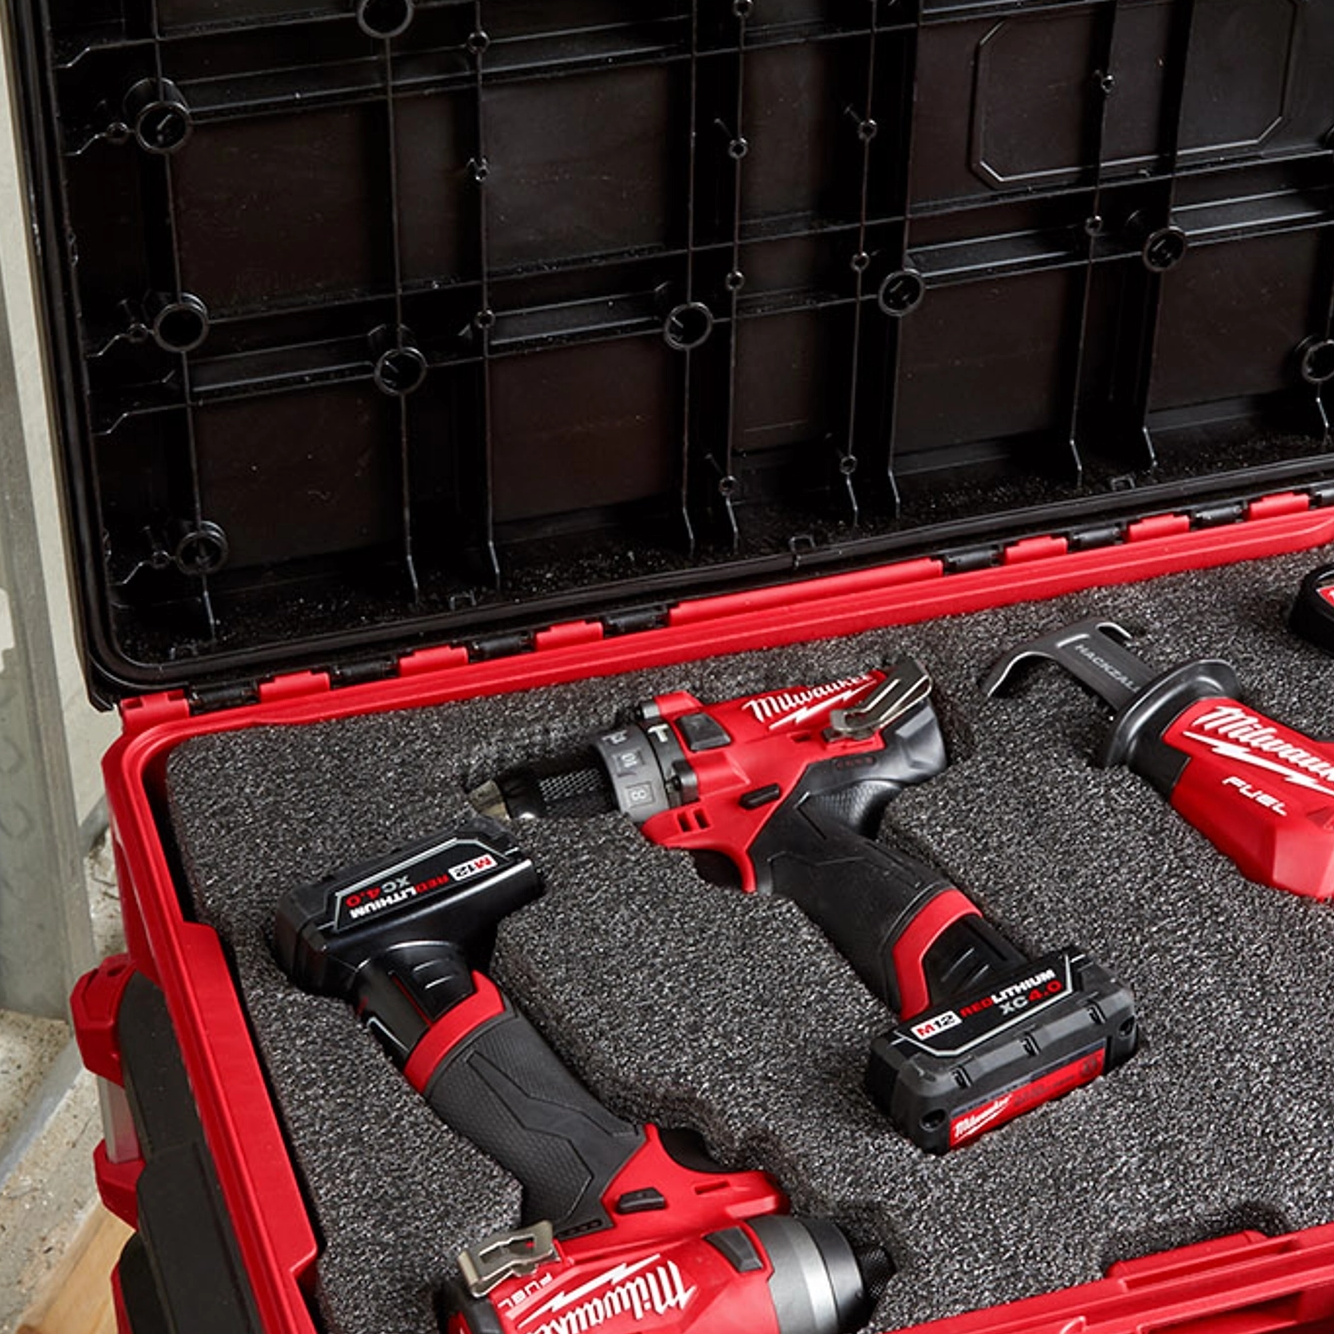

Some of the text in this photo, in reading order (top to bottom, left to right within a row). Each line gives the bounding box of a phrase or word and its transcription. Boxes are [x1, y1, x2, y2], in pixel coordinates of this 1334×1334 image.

[741, 673, 870, 723] Milwaukee
[1222, 775, 1287, 816] FUEL
[349, 856, 493, 918] M12 REDLITHIUM
[916, 969, 1057, 1037] M12 REDLITHIUM
[498, 1272, 553, 1308] FUEL
